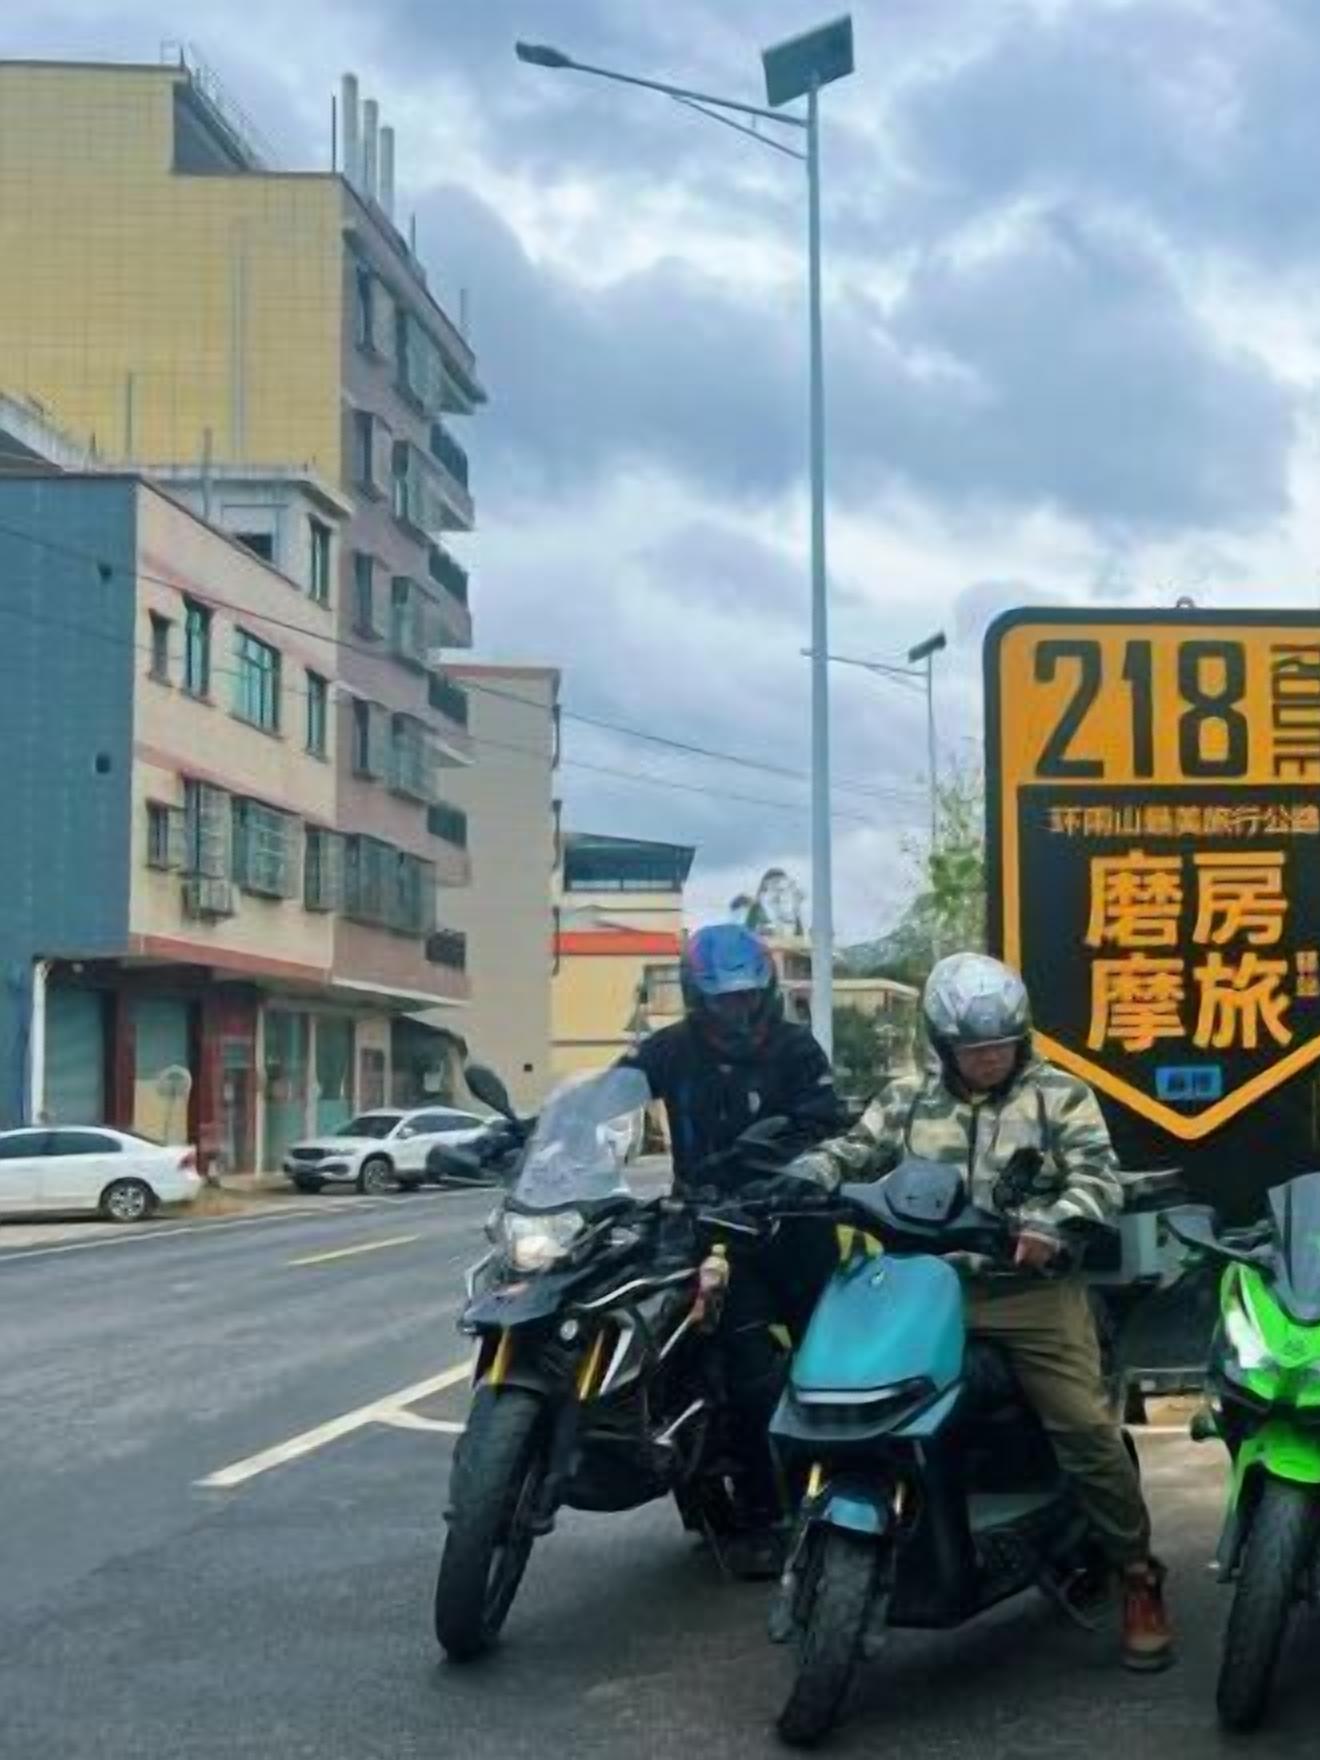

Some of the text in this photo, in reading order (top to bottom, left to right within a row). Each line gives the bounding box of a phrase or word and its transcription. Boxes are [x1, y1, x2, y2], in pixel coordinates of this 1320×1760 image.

[1034, 639, 1248, 778] 218
[1085, 849, 1288, 947] 磨房
[1087, 951, 1294, 1052] 摩旅
